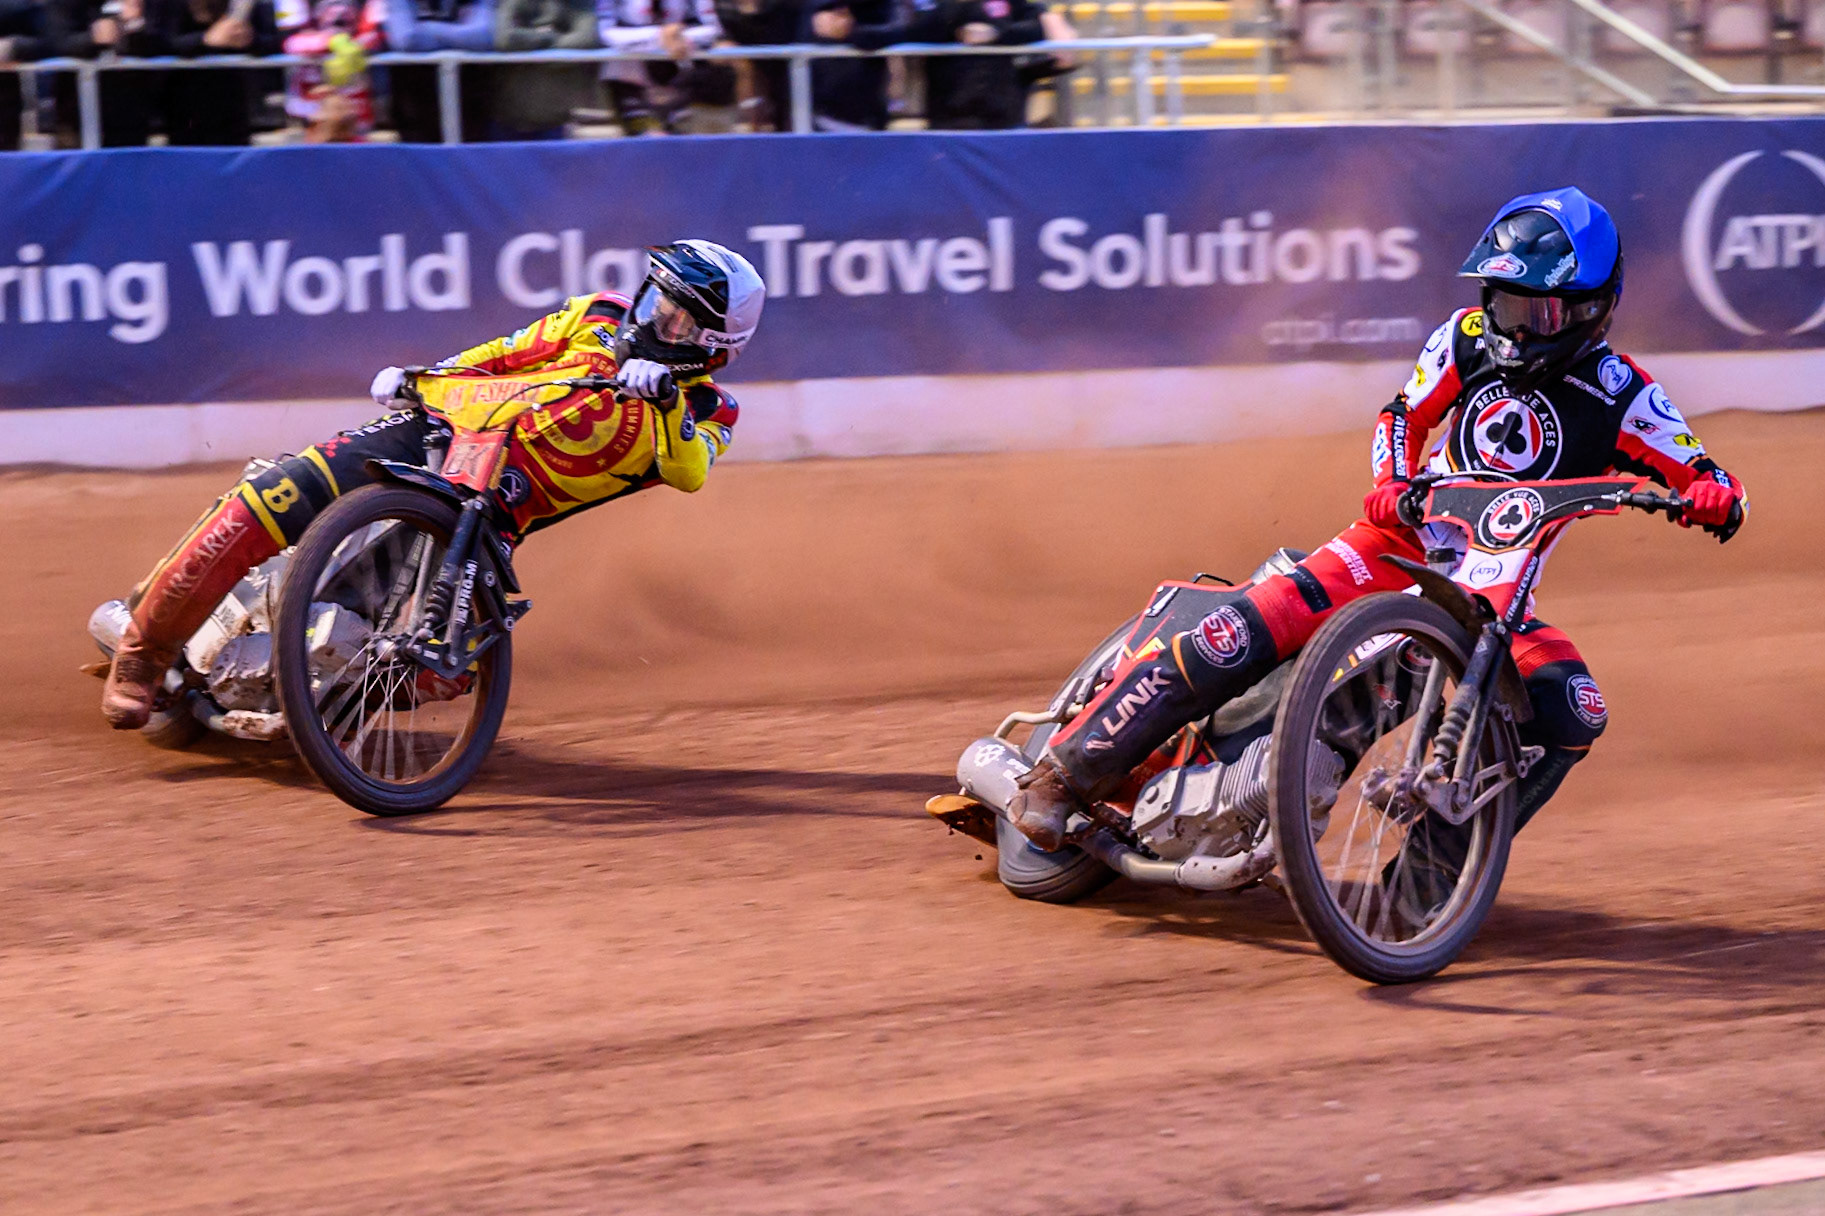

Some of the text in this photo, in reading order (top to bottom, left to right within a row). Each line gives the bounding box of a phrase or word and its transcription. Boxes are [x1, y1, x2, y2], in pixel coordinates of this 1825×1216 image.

[191, 232, 471, 317] World
[748, 217, 1014, 298] Travel
[1038, 211, 1421, 291] Solutions
[1475, 386, 1509, 410] BELLE
[1538, 412, 1556, 447] ACES
[261, 477, 299, 513] B
[1513, 491, 1529, 499] VUE
[1205, 614, 1236, 653] STS
[1102, 666, 1173, 736] LINK
[1578, 690, 1606, 708] STS
